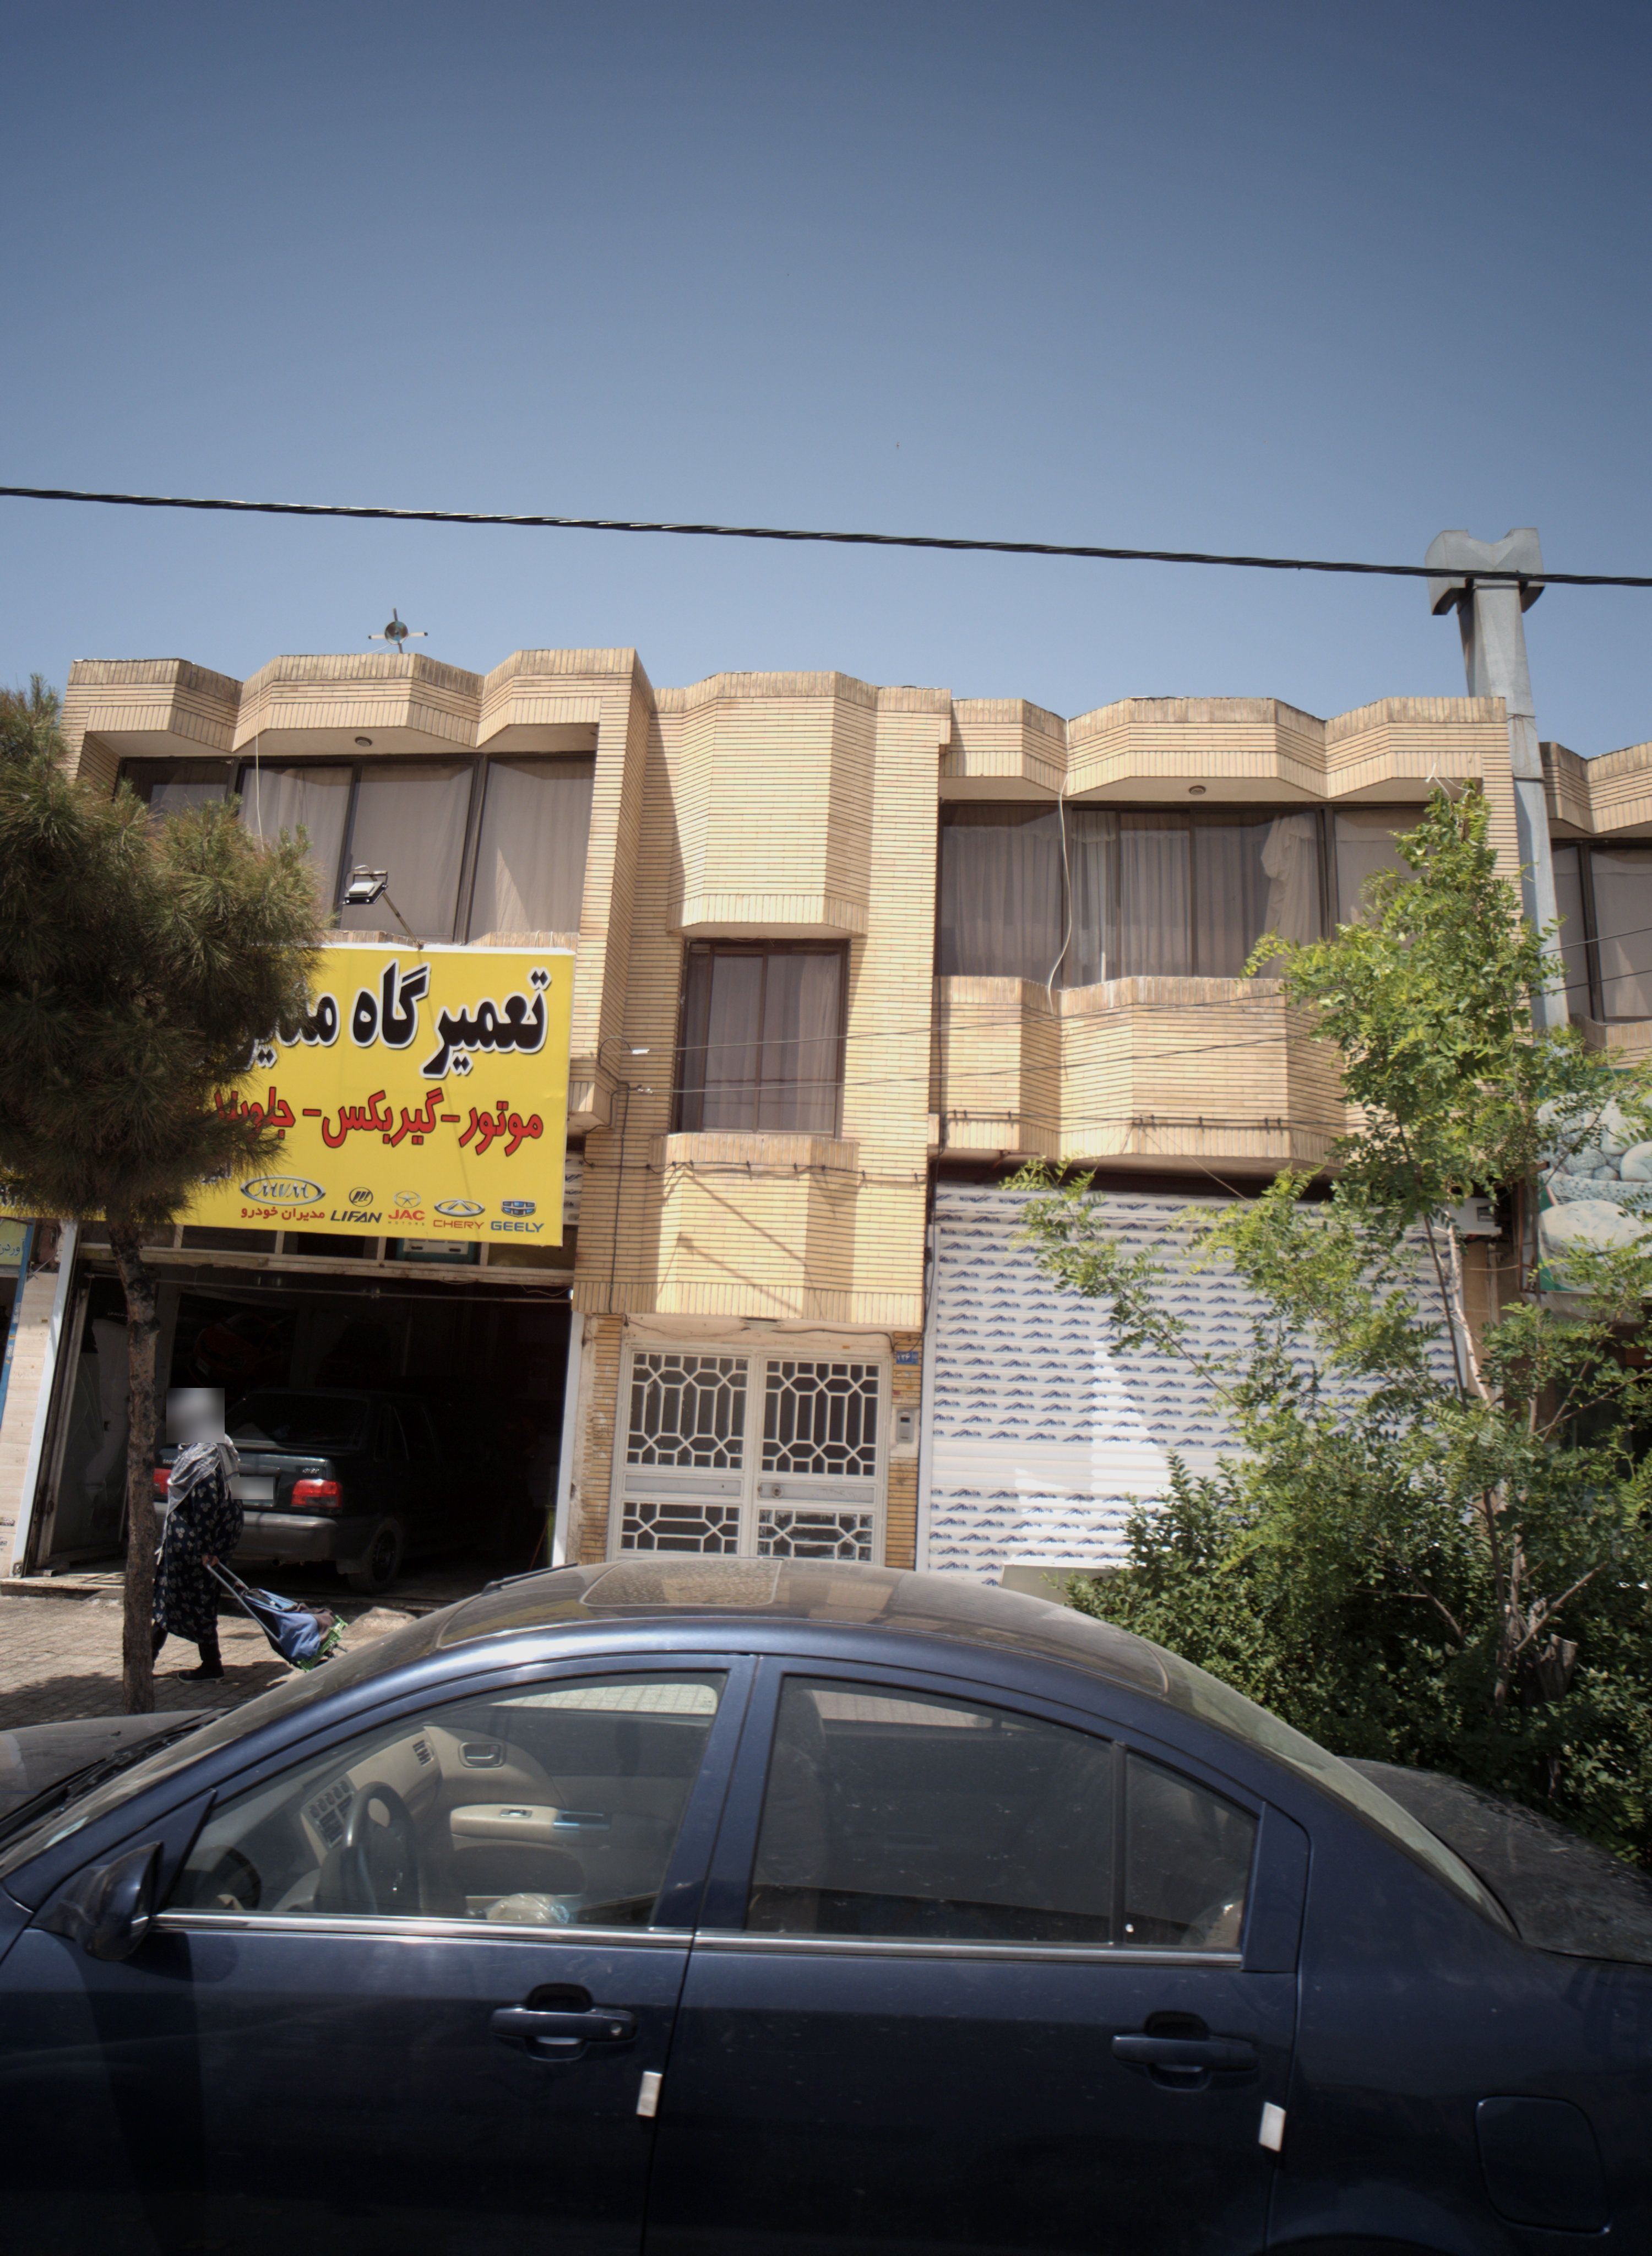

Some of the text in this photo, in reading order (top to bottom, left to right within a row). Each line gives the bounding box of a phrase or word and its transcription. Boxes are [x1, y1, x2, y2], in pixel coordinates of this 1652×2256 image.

[459, 1100, 544, 1156] موتور
[253, 1182, 309, 1198] MVM
[241, 1206, 325, 1221] مدیران خودرو
[330, 1210, 383, 1223] LIFAN
[388, 1210, 425, 1221] JAC
[433, 1219, 485, 1230] CHERY
[491, 1221, 545, 1233] GEELY
